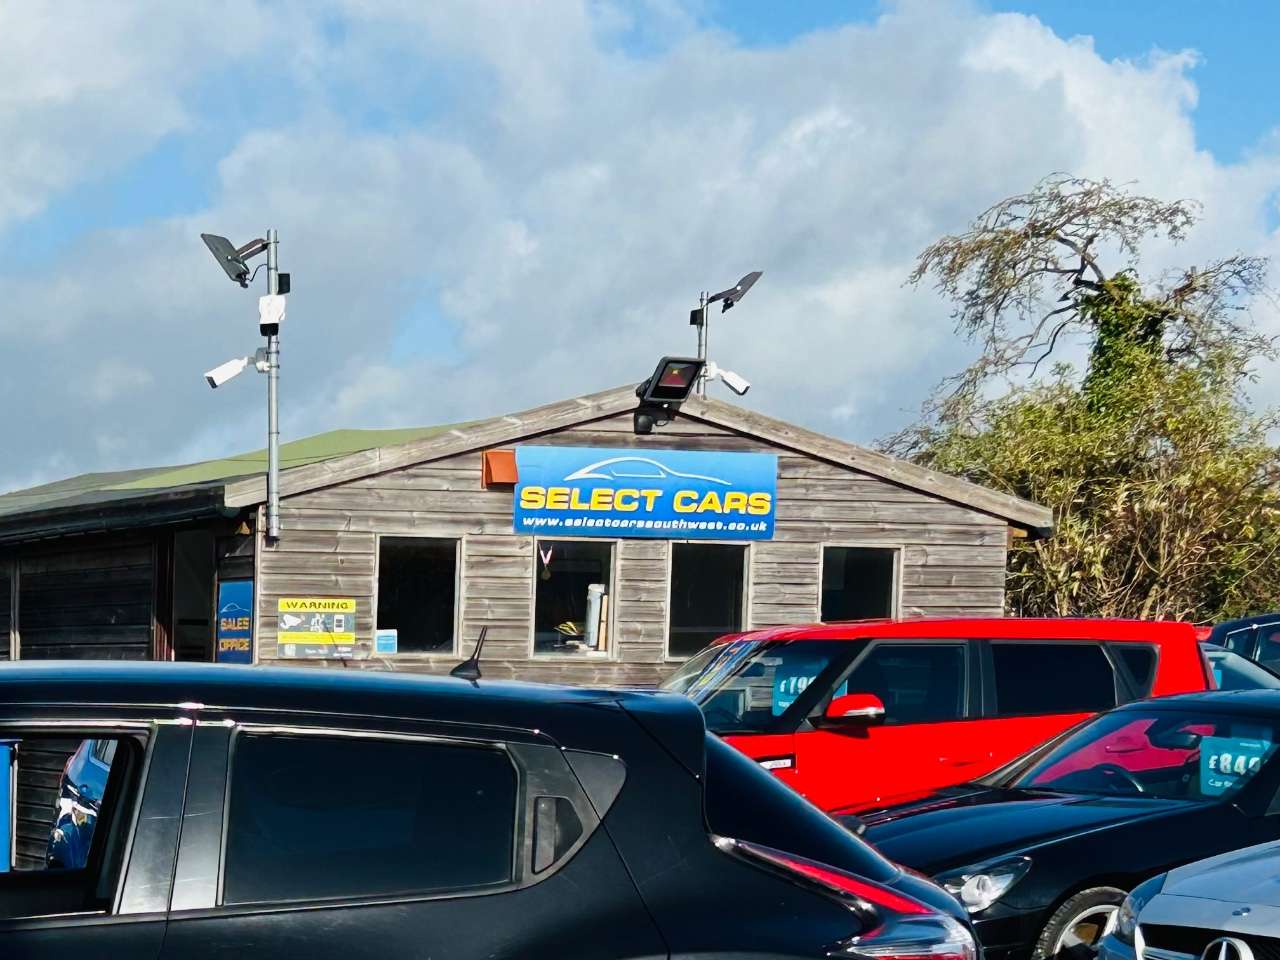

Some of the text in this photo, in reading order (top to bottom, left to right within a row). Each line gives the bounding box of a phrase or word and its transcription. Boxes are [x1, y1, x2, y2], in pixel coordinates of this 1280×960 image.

[519, 486, 772, 515] SELECT CARS
[522, 516, 768, 532] www.selectcarssouthwest.co.uk
[286, 601, 349, 610] WARNING
[220, 617, 250, 630] SALES
